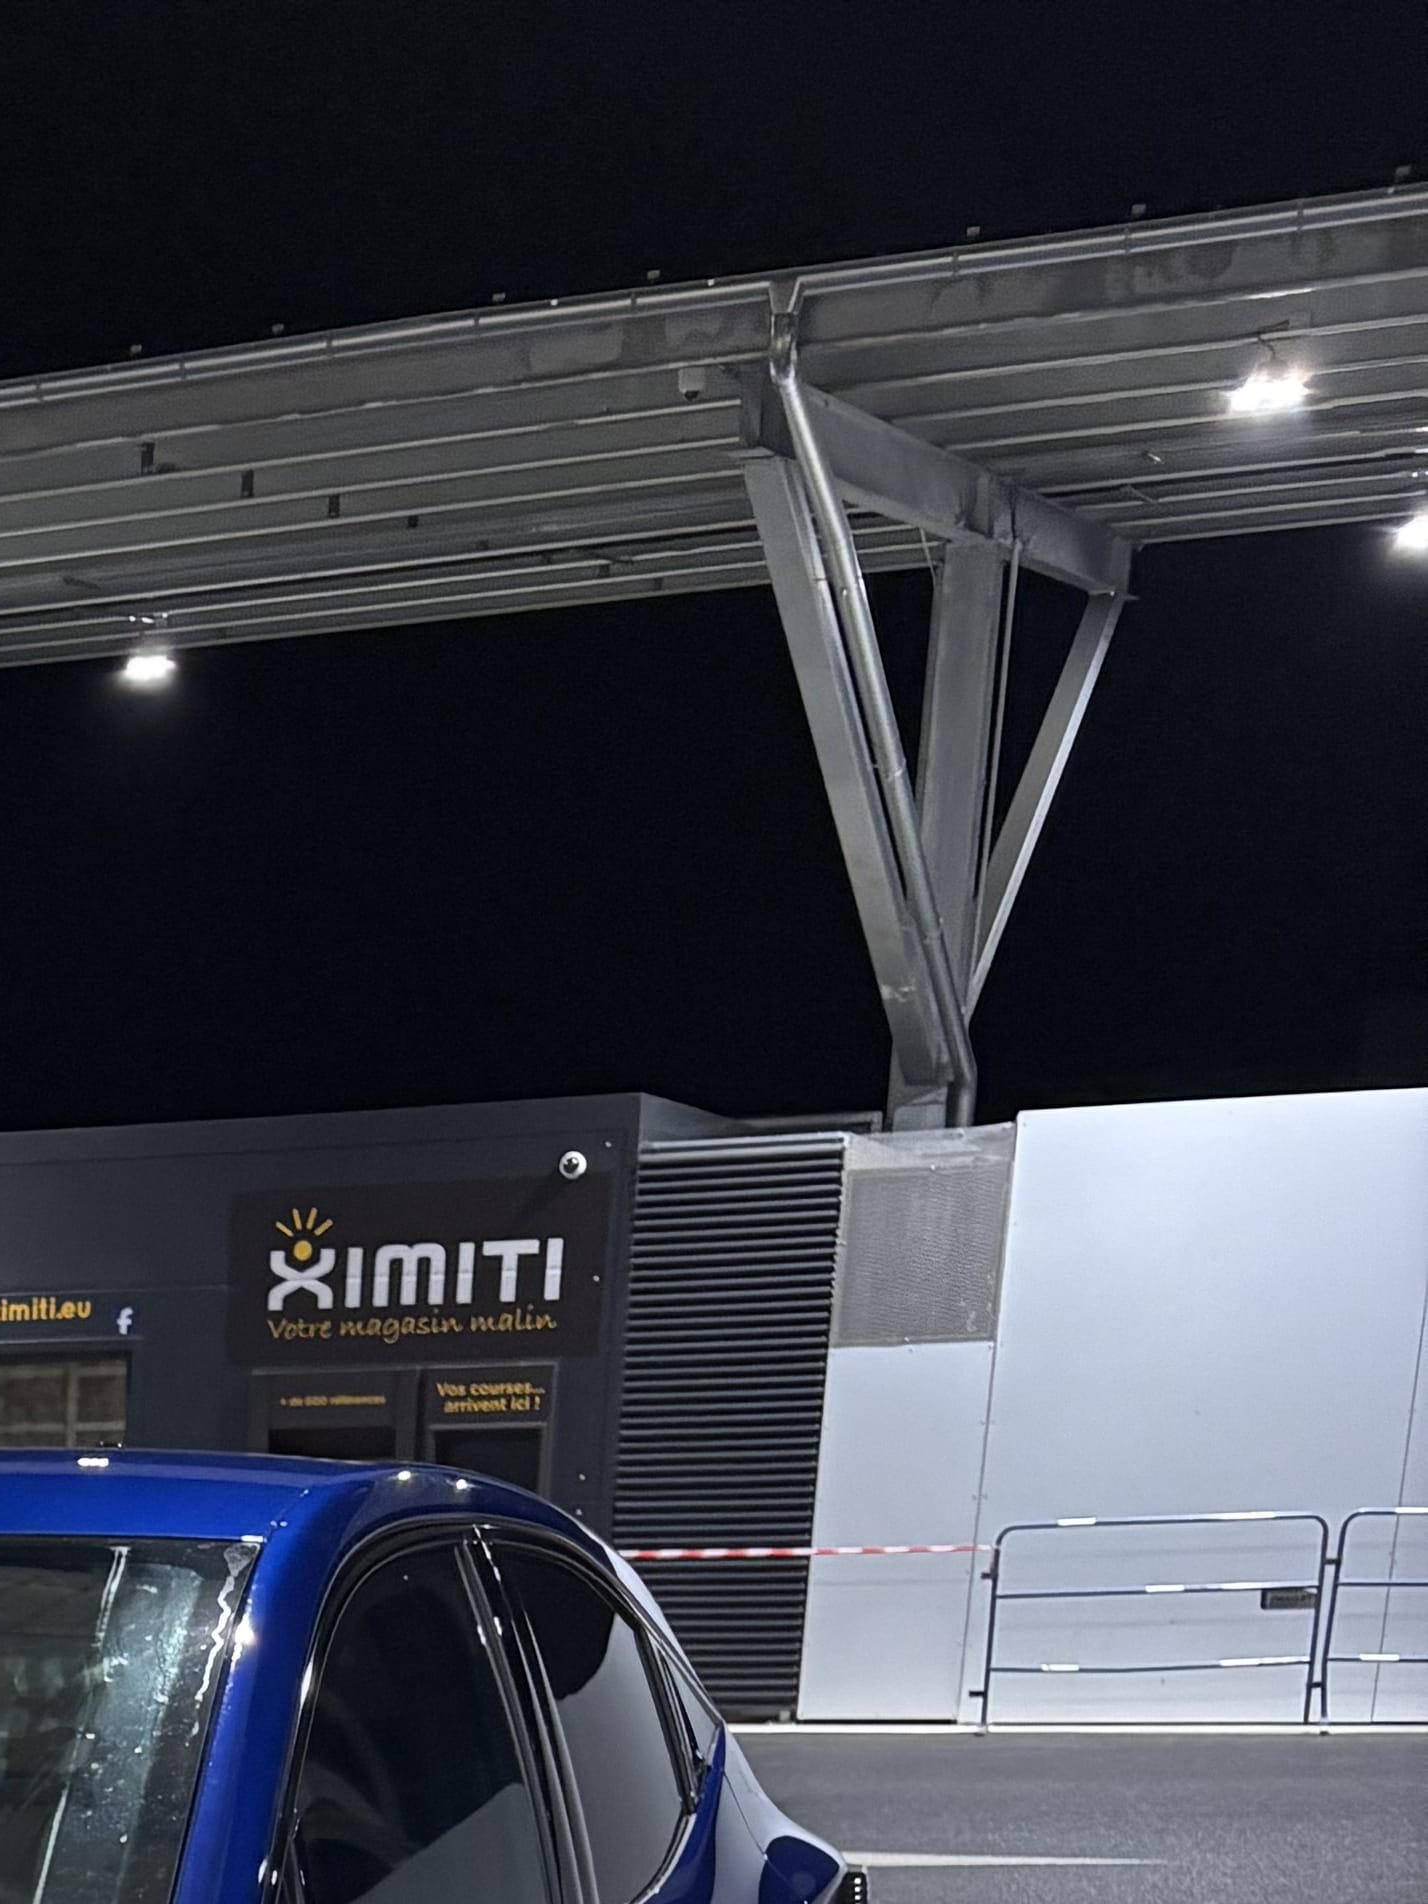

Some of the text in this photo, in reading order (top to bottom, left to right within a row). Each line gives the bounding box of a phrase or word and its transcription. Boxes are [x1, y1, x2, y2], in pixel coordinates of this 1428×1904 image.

[267, 1237, 564, 1311] XIMITI
[267, 1303, 557, 1344] Votre magasin malin
